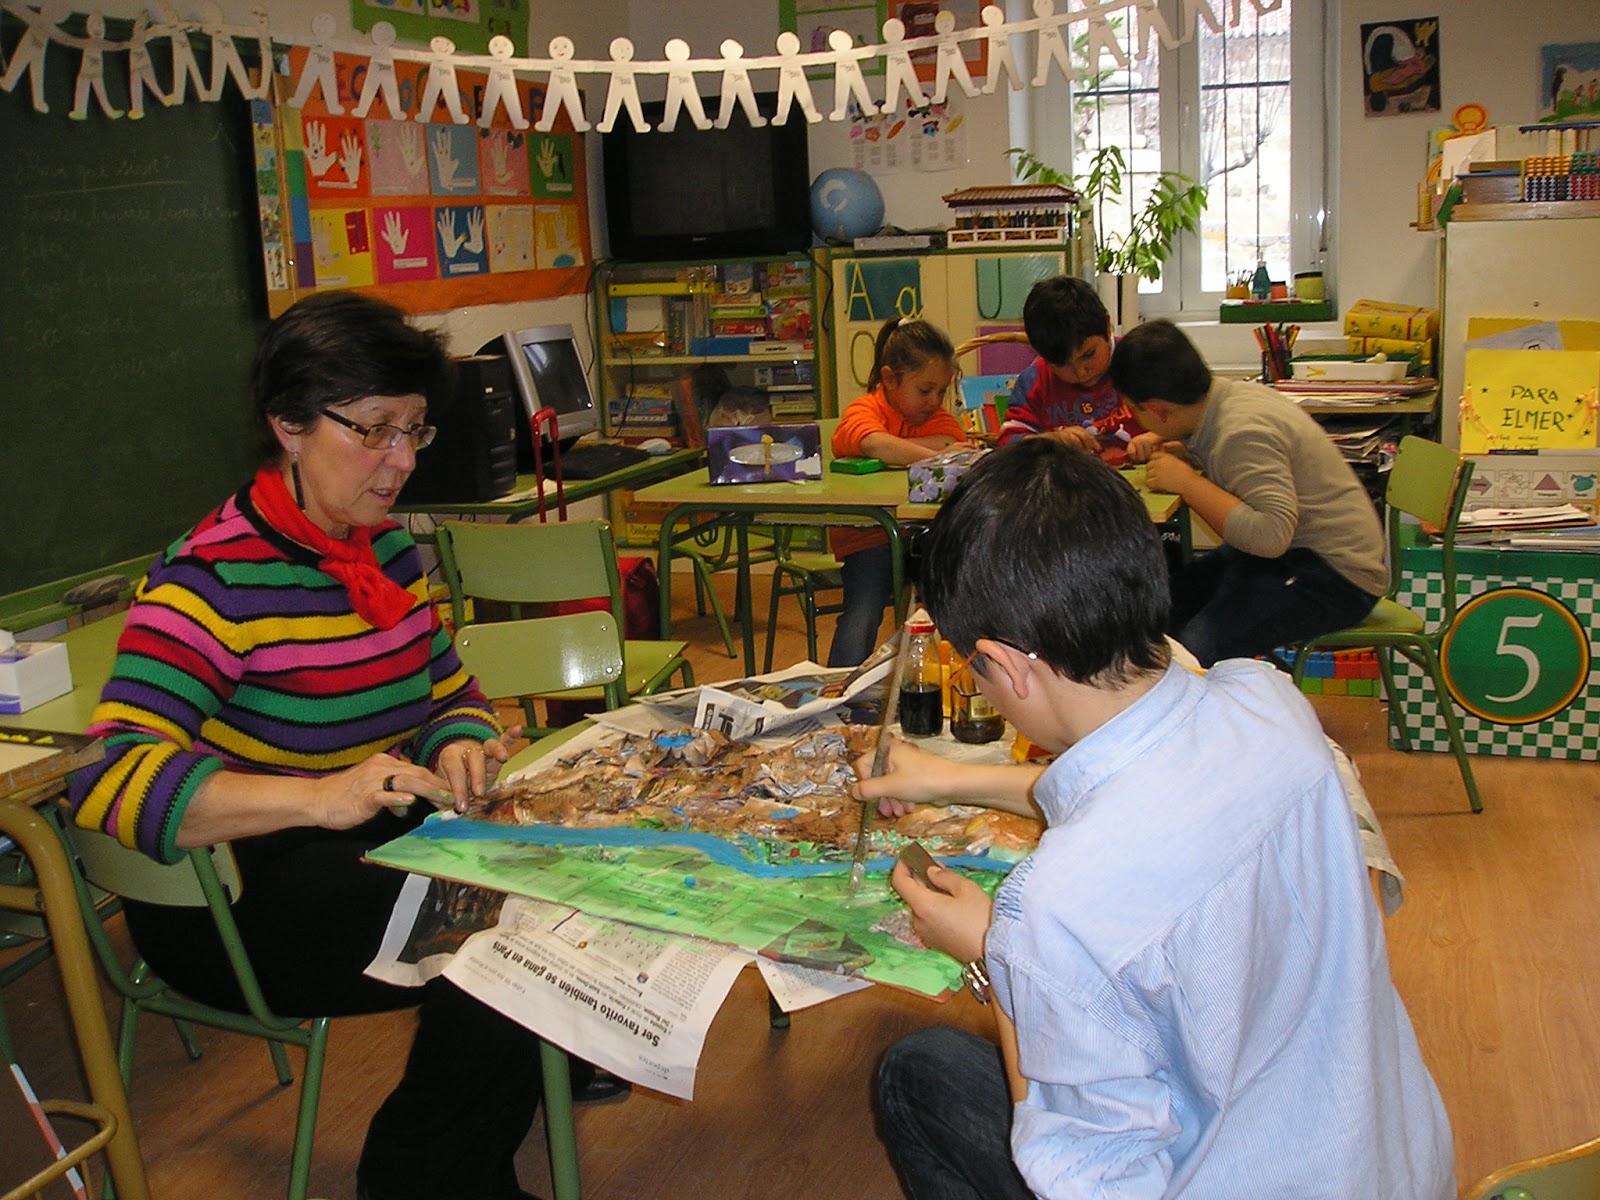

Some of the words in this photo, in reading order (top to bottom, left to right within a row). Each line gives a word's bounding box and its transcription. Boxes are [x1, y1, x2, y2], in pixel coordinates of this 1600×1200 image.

[847, 262, 875, 320] A
[975, 258, 1002, 319] U
[1511, 385, 1559, 405] PARA
[1081, 403, 1093, 414] is
[1501, 408, 1565, 432] ELMER
[1485, 613, 1543, 703] 5
[492, 940, 513, 960] París
[511, 952, 524, 964] en
[523, 958, 548, 977] gana
[544, 972, 558, 985] se
[558, 979, 598, 1011] también
[599, 1004, 640, 1036] favorito
[641, 1028, 661, 1047] Ser
